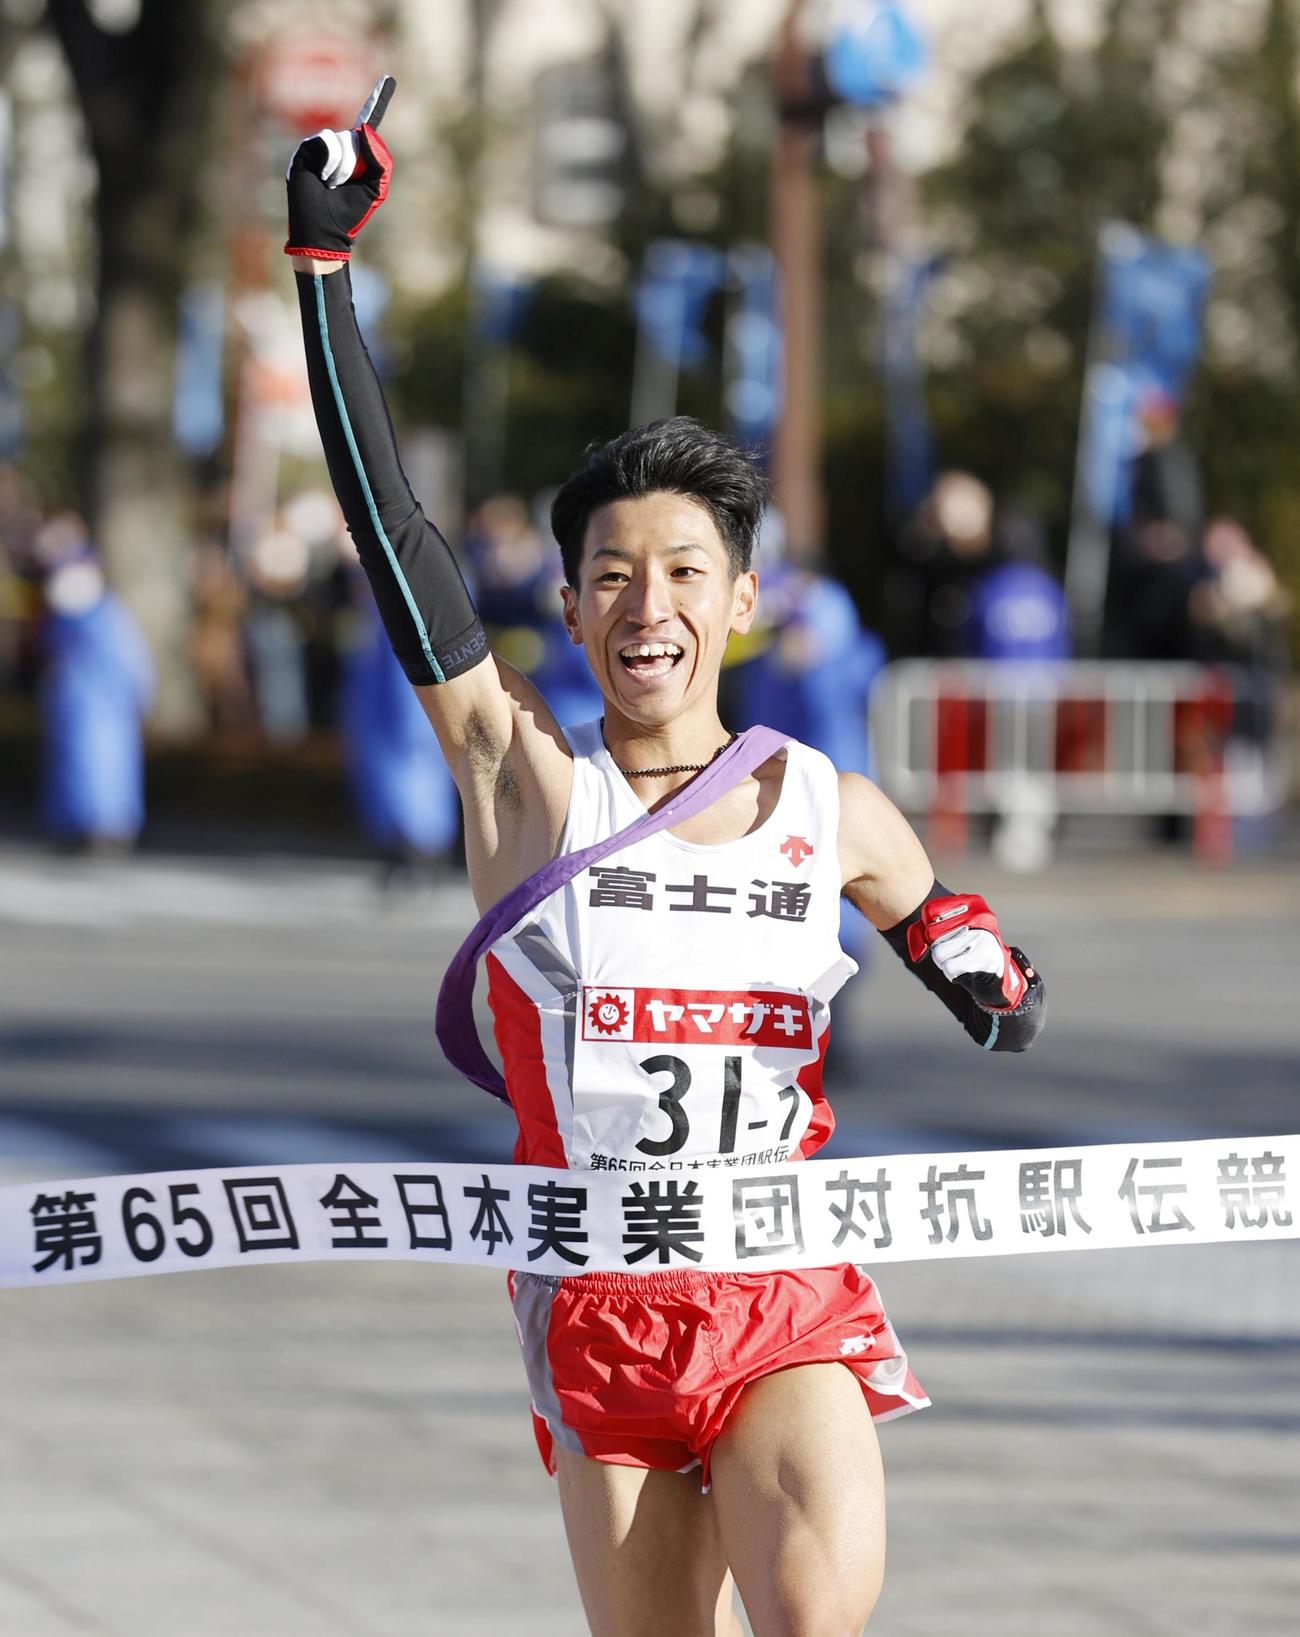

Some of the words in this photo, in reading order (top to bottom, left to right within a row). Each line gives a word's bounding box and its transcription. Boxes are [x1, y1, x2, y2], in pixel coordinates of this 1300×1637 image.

[589, 866, 811, 922] 富士通
[645, 999, 804, 1037] ヤマザキ
